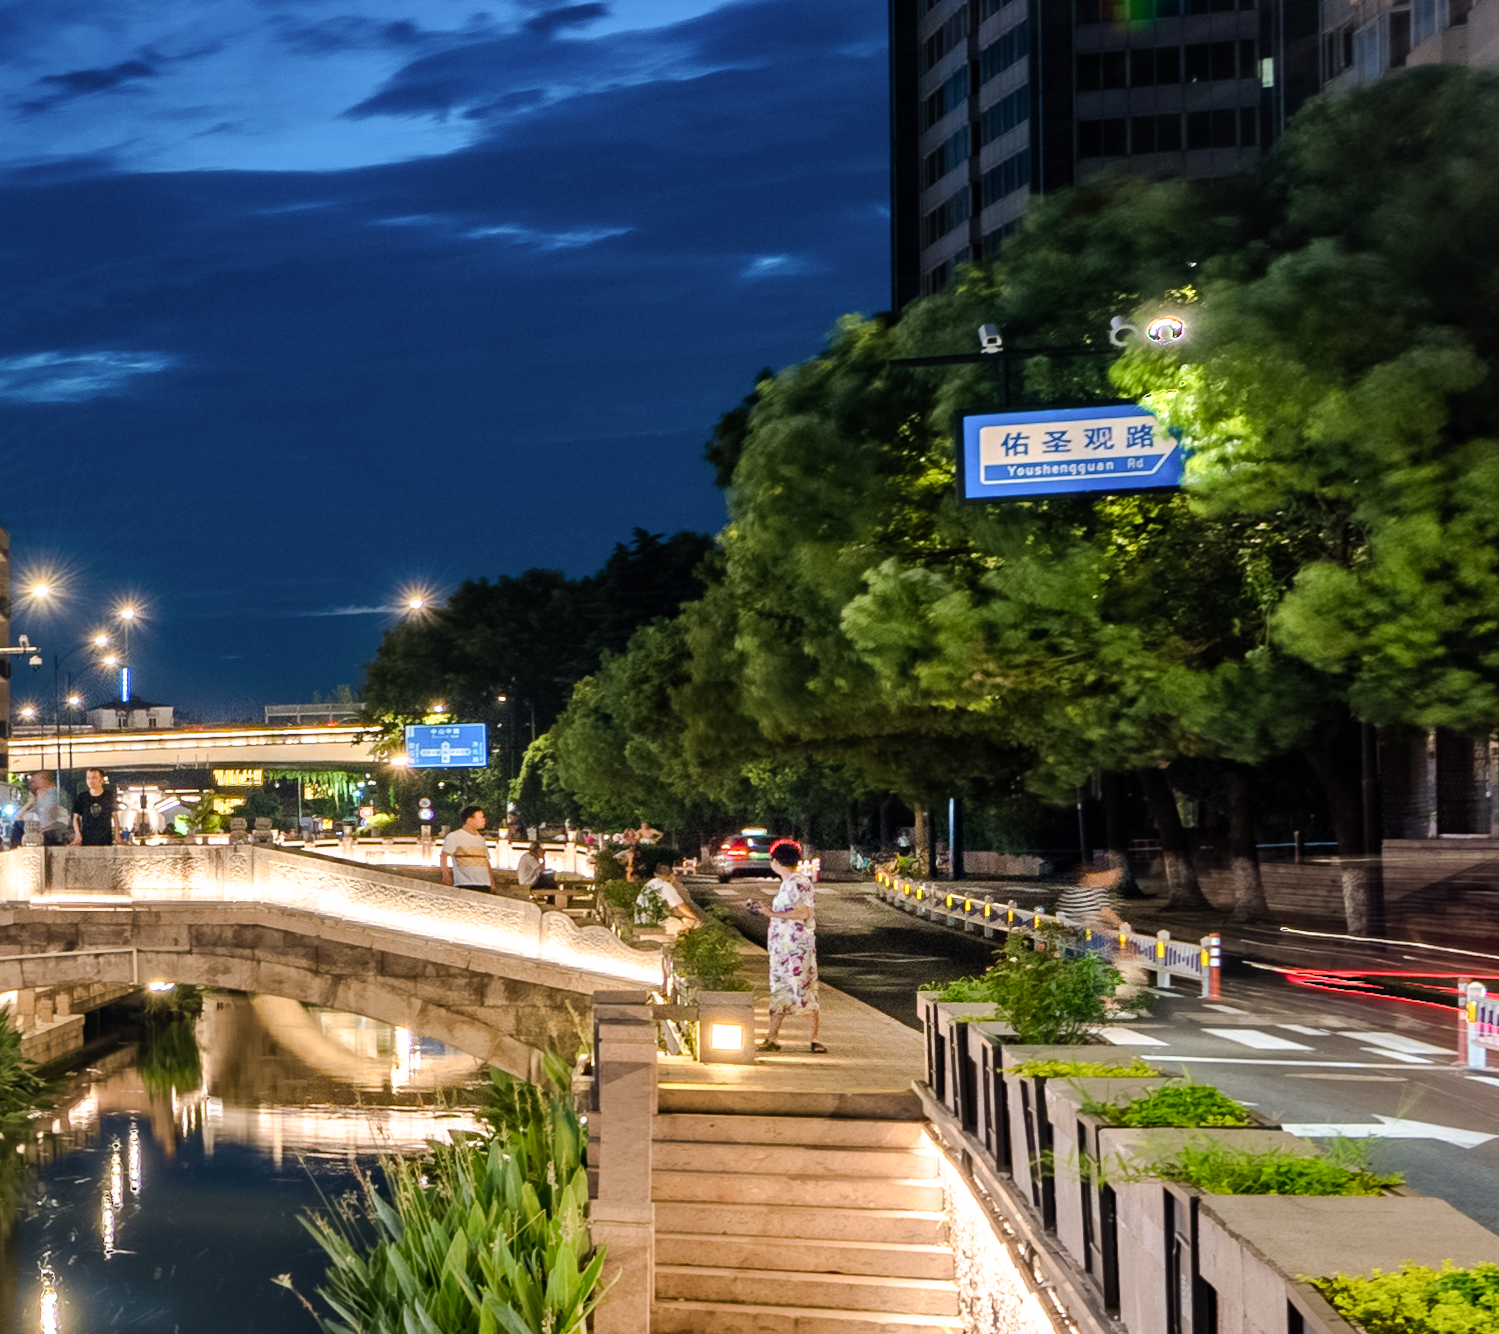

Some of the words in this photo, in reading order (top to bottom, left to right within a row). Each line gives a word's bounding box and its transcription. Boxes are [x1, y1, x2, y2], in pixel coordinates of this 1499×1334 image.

[1000, 424, 1154, 457] 佑圣观路
[1007, 460, 1114, 477] Youshengguan
[1127, 457, 1144, 469] Rd
